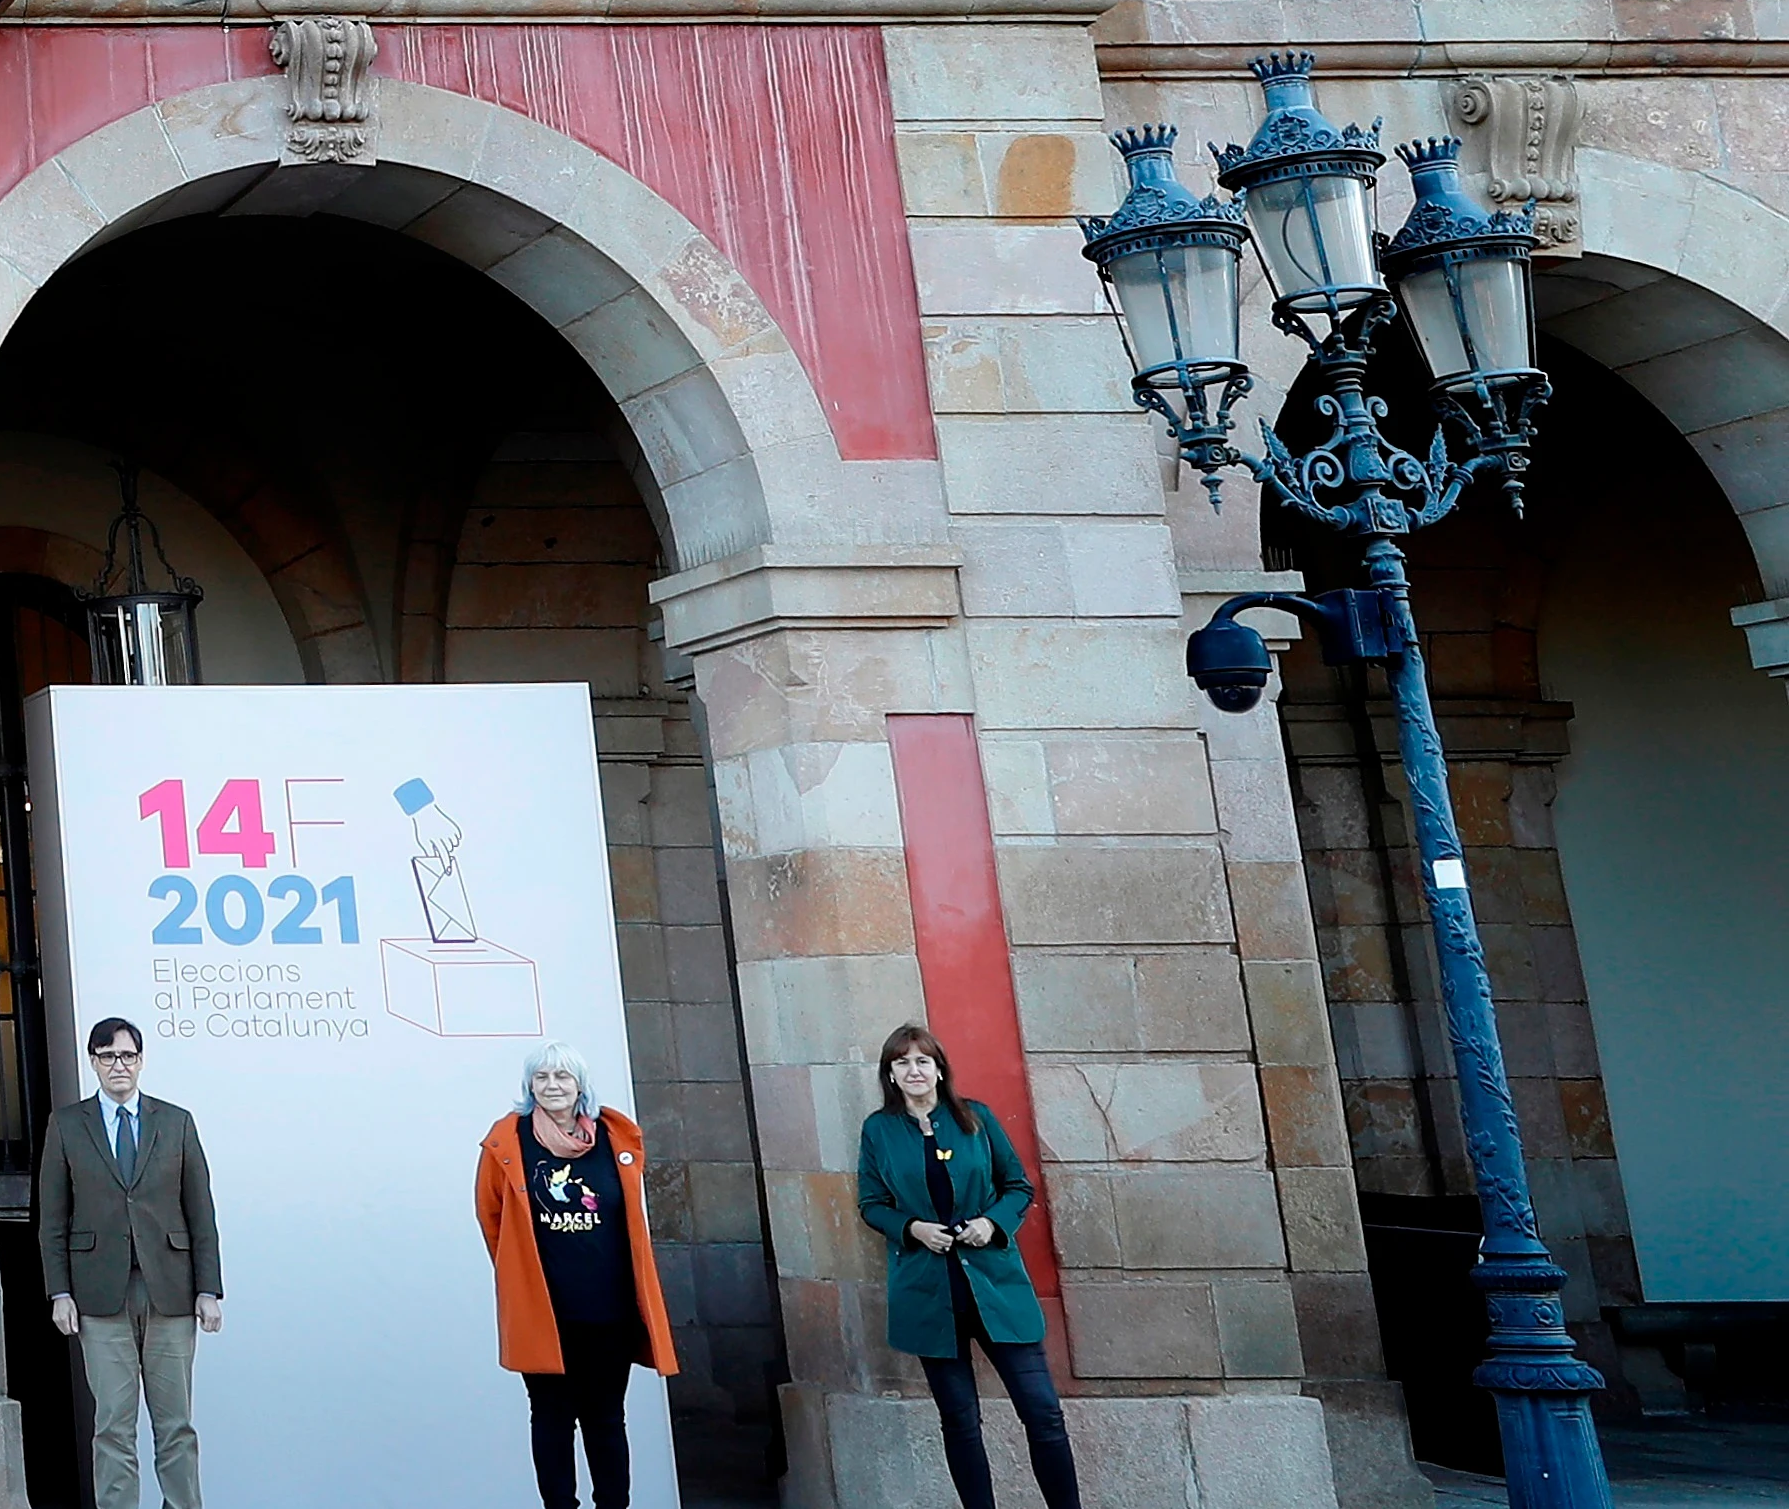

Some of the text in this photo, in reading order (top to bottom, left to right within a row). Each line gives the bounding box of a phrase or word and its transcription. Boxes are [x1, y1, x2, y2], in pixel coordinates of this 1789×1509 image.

[139, 779, 345, 868] 14F
[148, 875, 360, 946] 2021
[153, 958, 301, 983] Eleccions
[154, 985, 357, 1011] al Parlament
[157, 1012, 369, 1042] de Catalunya
[540, 1212, 600, 1224] MARCEL
